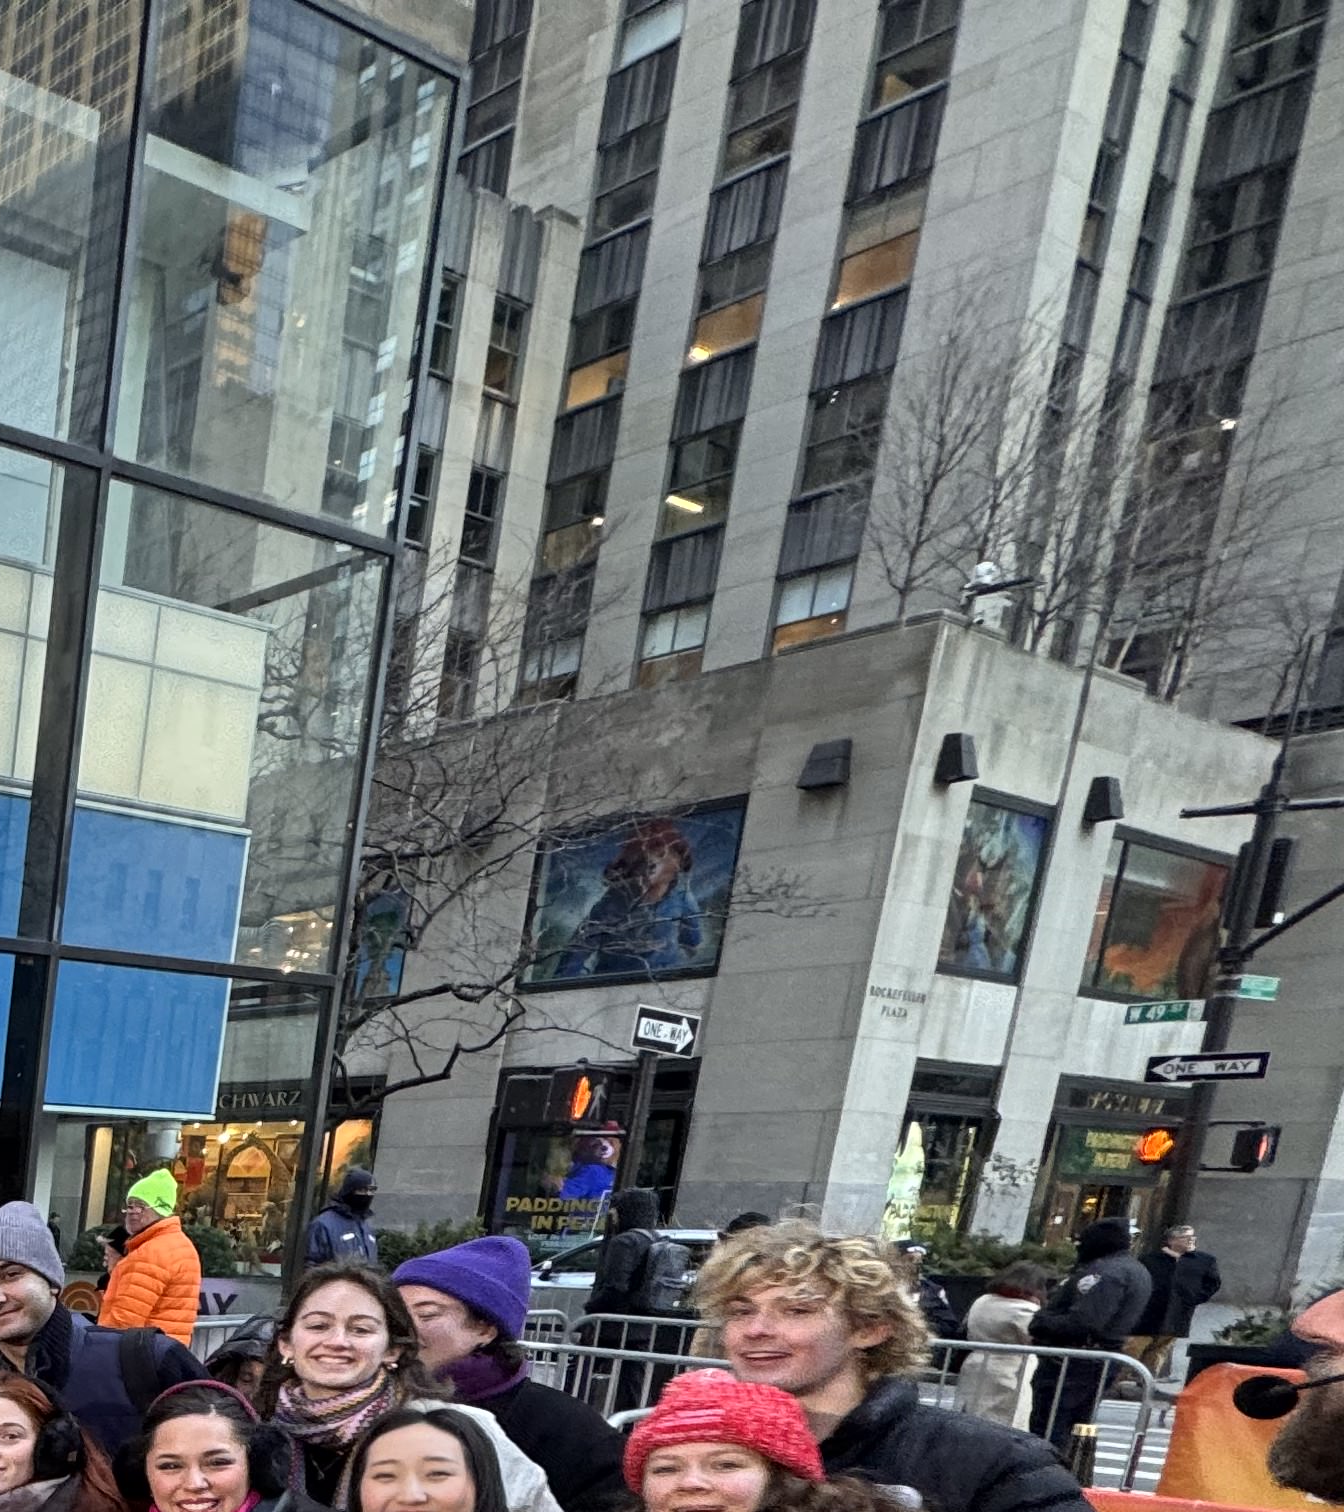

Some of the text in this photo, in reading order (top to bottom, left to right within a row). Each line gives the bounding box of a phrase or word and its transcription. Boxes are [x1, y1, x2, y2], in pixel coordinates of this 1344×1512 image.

[880, 1005, 908, 1018] PLAZA
[1129, 1007, 1143, 1022] W
[1145, 1004, 1167, 1020] 49
[644, 1020, 689, 1042] ONE WAY
[1163, 1060, 1255, 1075] ONE WAY
[219, 1090, 301, 1109] CHWARZ
[506, 1196, 600, 1213] PADDING
[531, 1215, 553, 1230] IN
